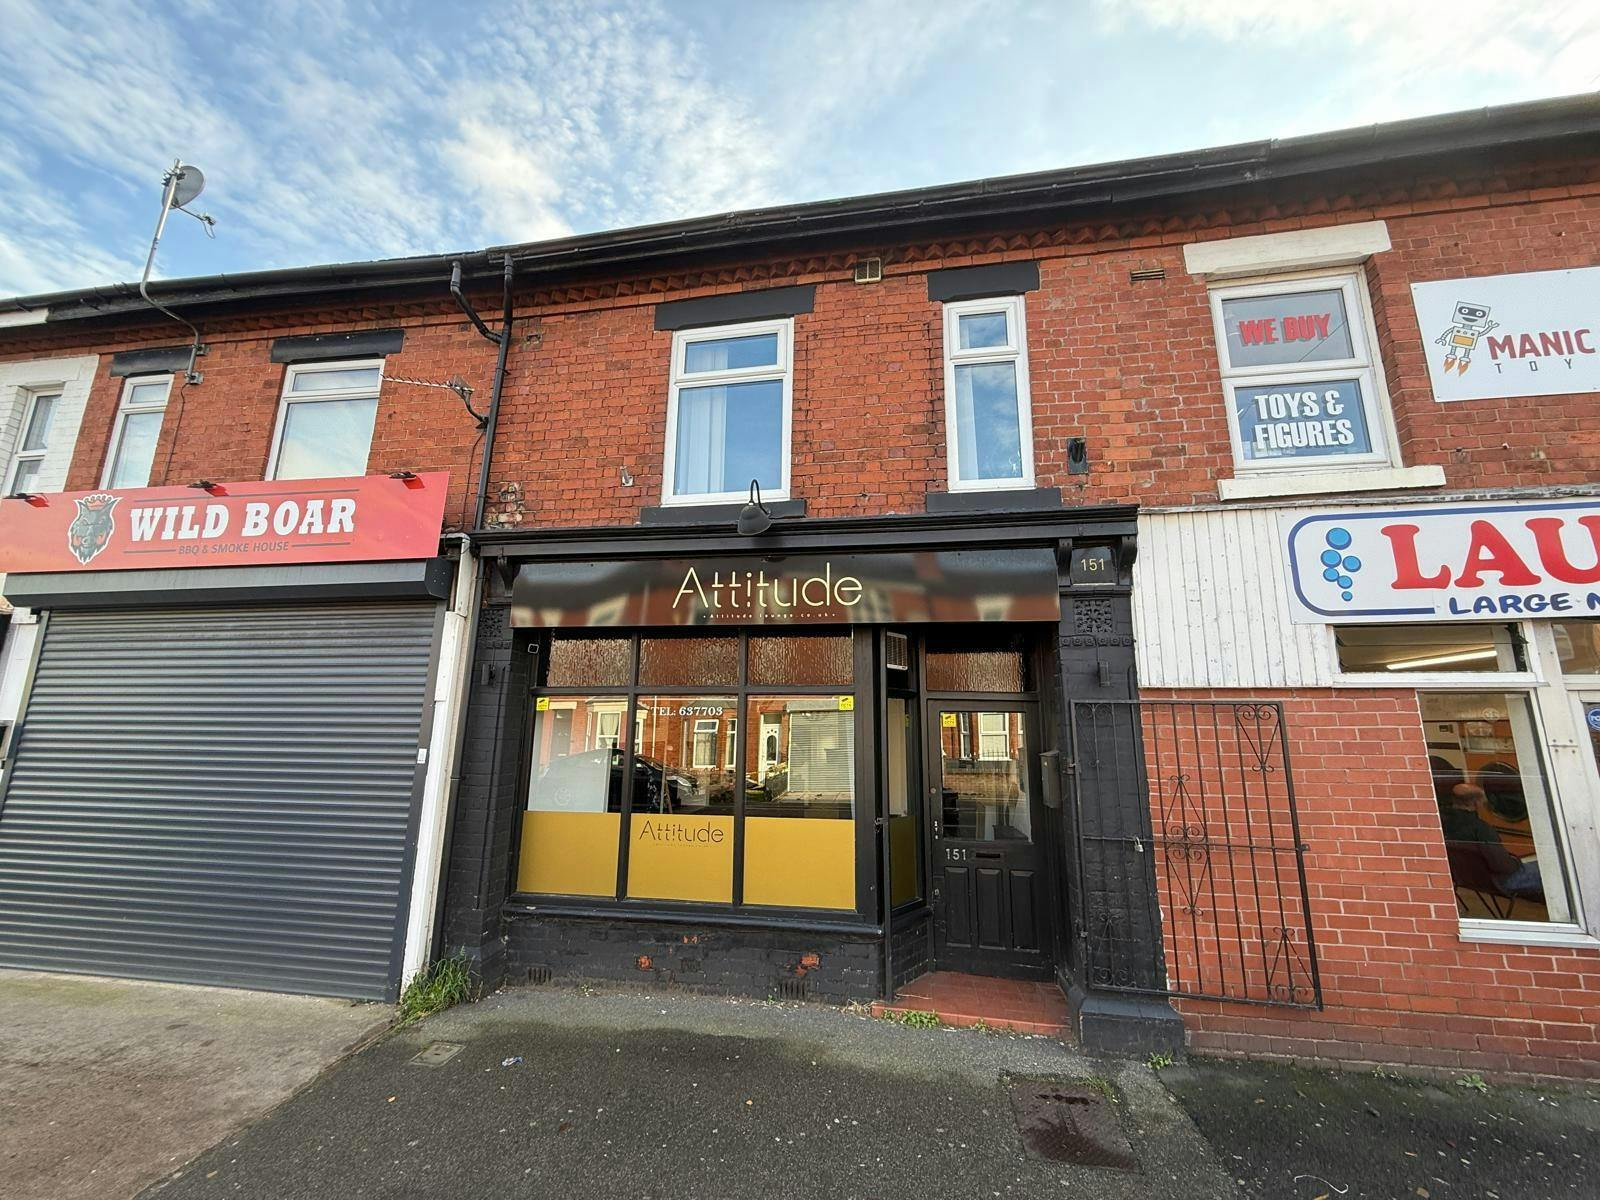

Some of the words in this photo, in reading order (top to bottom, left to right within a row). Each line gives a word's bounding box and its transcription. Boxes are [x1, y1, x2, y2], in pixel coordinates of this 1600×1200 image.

[1239, 317, 1279, 345] WE
[1282, 313, 1331, 343] BUY
[1486, 329, 1596, 360] MANIC
[1254, 391, 1320, 420] TOYS
[1324, 390, 1345, 416] &
[1254, 418, 1355, 449] FIGURES
[130, 505, 229, 541] WILD
[241, 498, 356, 536] BOAR
[178, 544, 199, 556] BBQ
[202, 544, 208, 554] &
[211, 543, 250, 554] SMOKE
[253, 541, 289, 552] HOUSE
[1380, 515, 1600, 589] LAU
[1080, 558, 1105, 571] 151
[672, 562, 863, 608] Attitude
[1449, 592, 1573, 615] LARGE
[651, 706, 676, 716] TEL:
[639, 819, 724, 843] Attitude
[945, 848, 966, 861] 151
